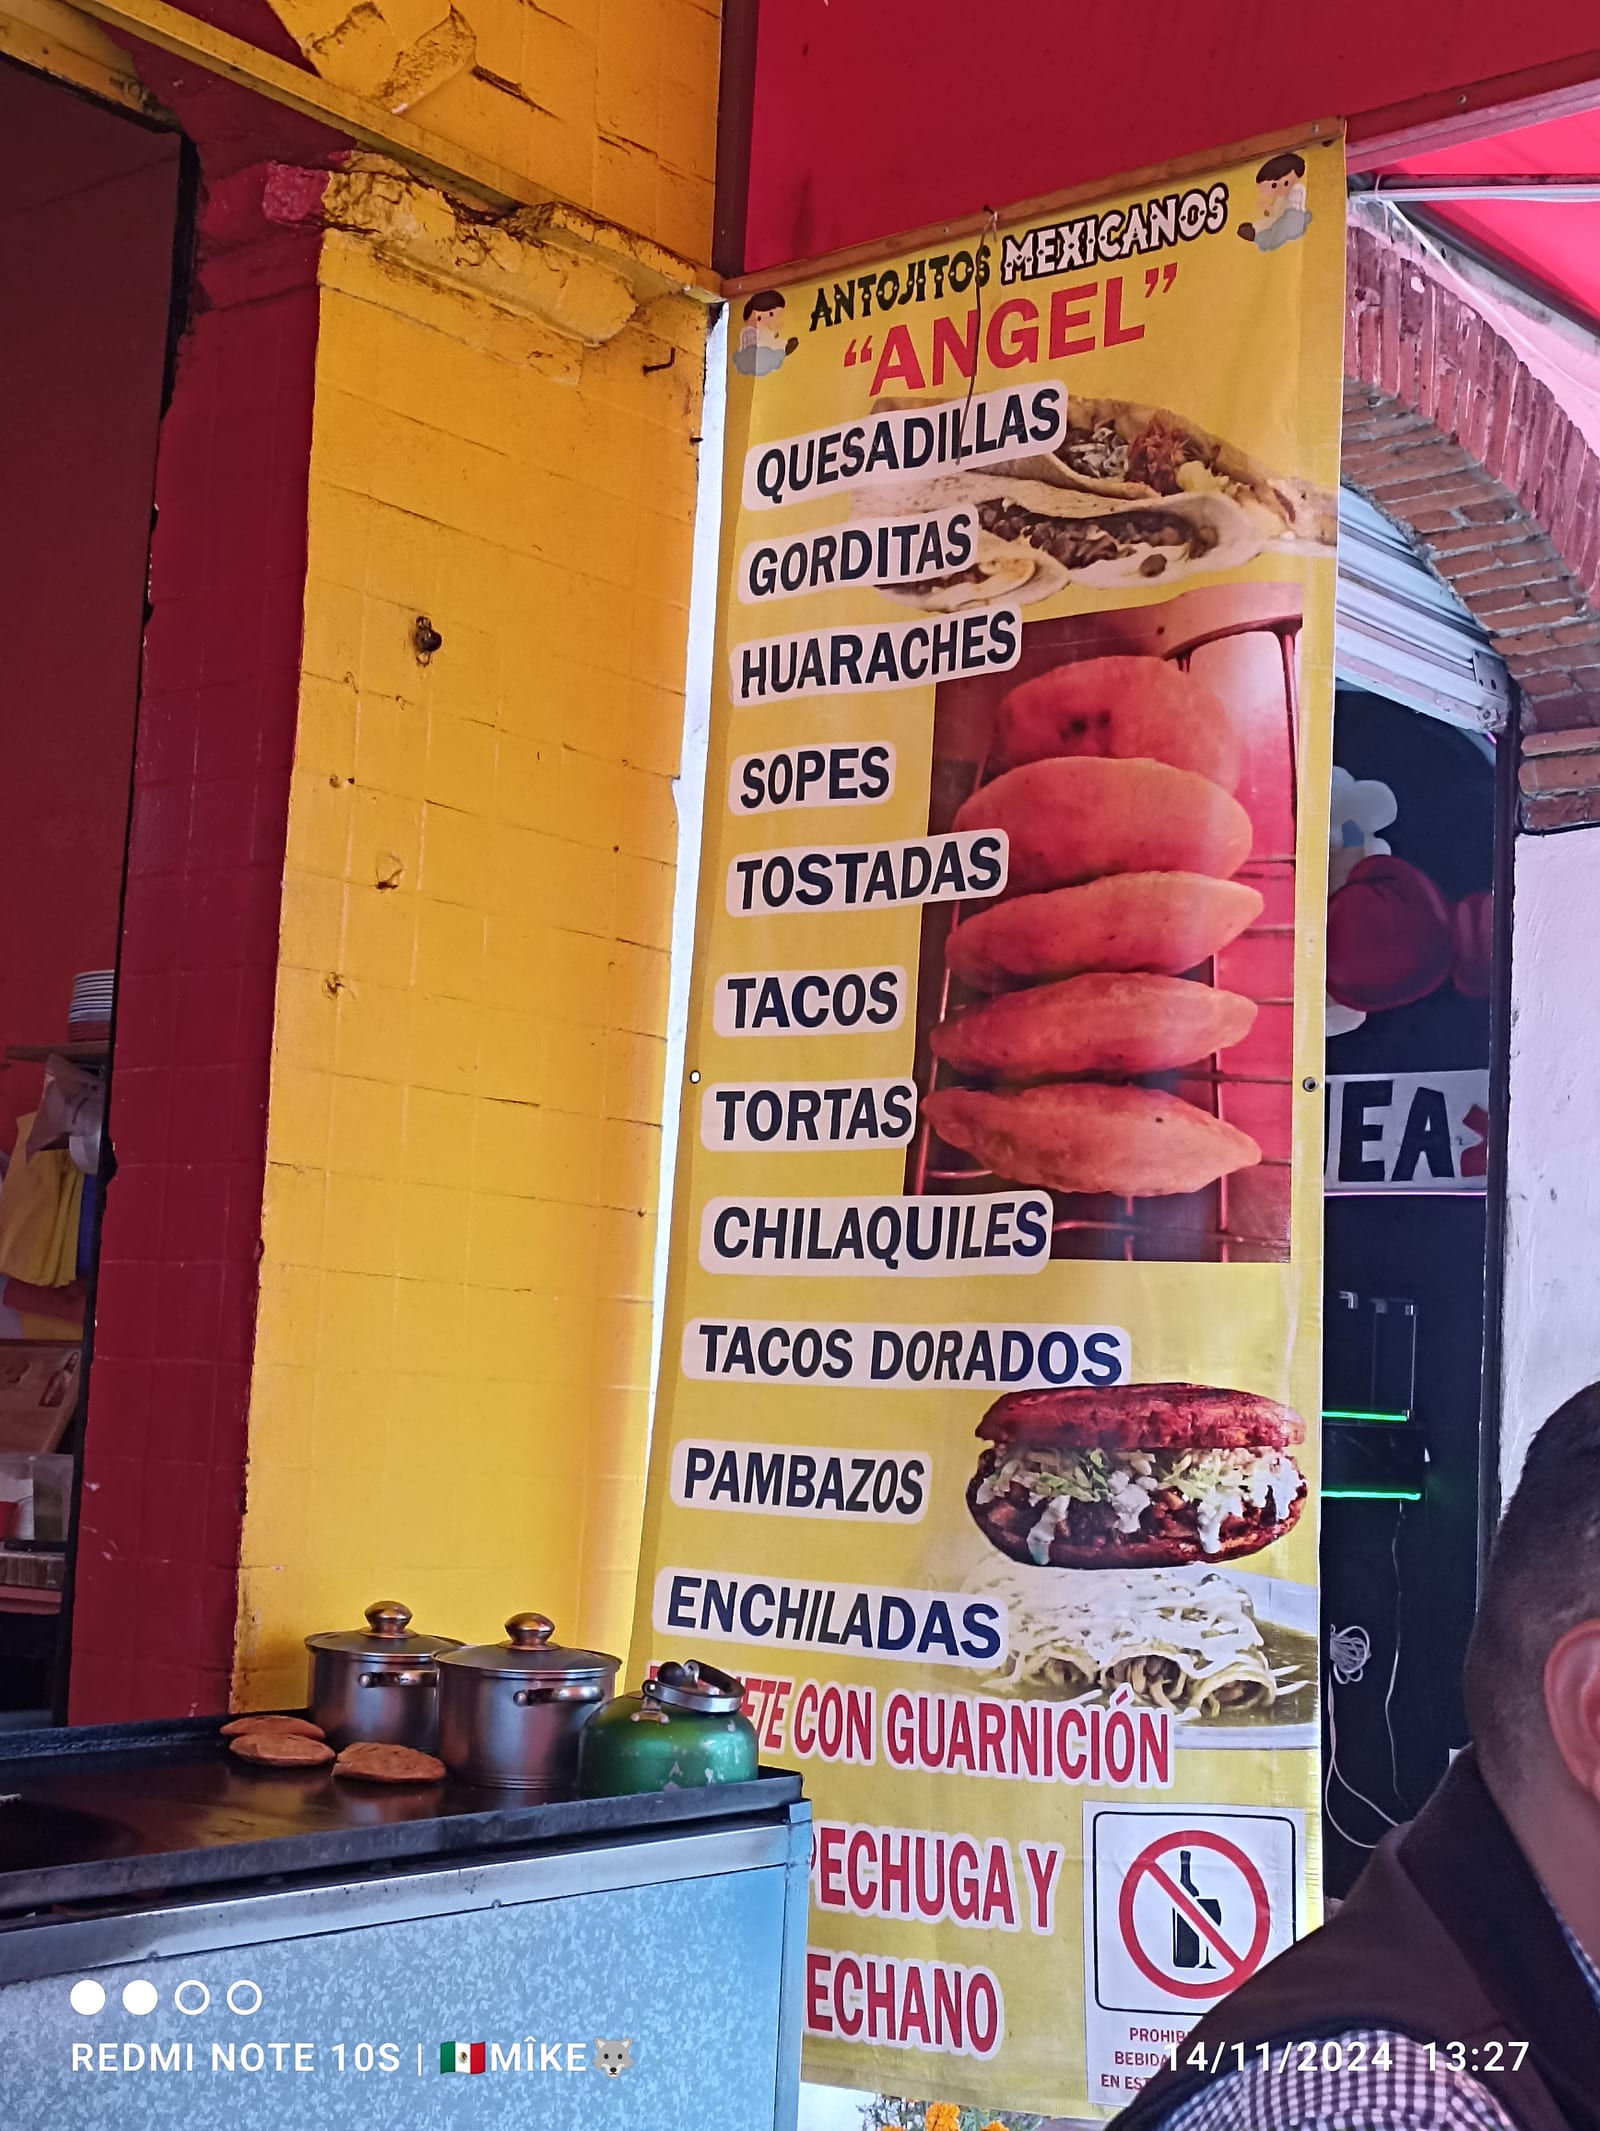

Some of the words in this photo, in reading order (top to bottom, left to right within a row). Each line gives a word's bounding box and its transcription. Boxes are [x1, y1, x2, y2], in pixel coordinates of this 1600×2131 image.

[809, 245, 991, 331] ANTOJITOS
[1000, 182, 1230, 285] MEXICANOS
[756, 387, 1061, 504] QUESADILLAS
[748, 513, 973, 597] GORDITAS
[740, 610, 1018, 698] HUARACHES
[740, 745, 891, 810] SOPES
[736, 836, 1002, 910] TOSTADAS
[727, 971, 899, 1029] TACOS
[715, 1084, 912, 1142] TORTAS
[713, 1202, 1048, 1269] CHILAQUILES
[700, 1324, 853, 1379] TACOS
[871, 1329, 1122, 1386] DORADOS
[683, 1447, 925, 1516] PAMBAZOS
[667, 1575, 1001, 1660] ENCHILADAS
[795, 1684, 872, 1760] CON
[887, 1689, 1169, 1785] GUARNICIÓN
[810, 1827, 1015, 1925] ECHUGA
[1026, 1848, 1058, 1928] Y
[806, 1953, 998, 2053] ECHANO
[1129, 2027, 1190, 2043] PROHIB
[1101, 2074, 1120, 2088] EN
